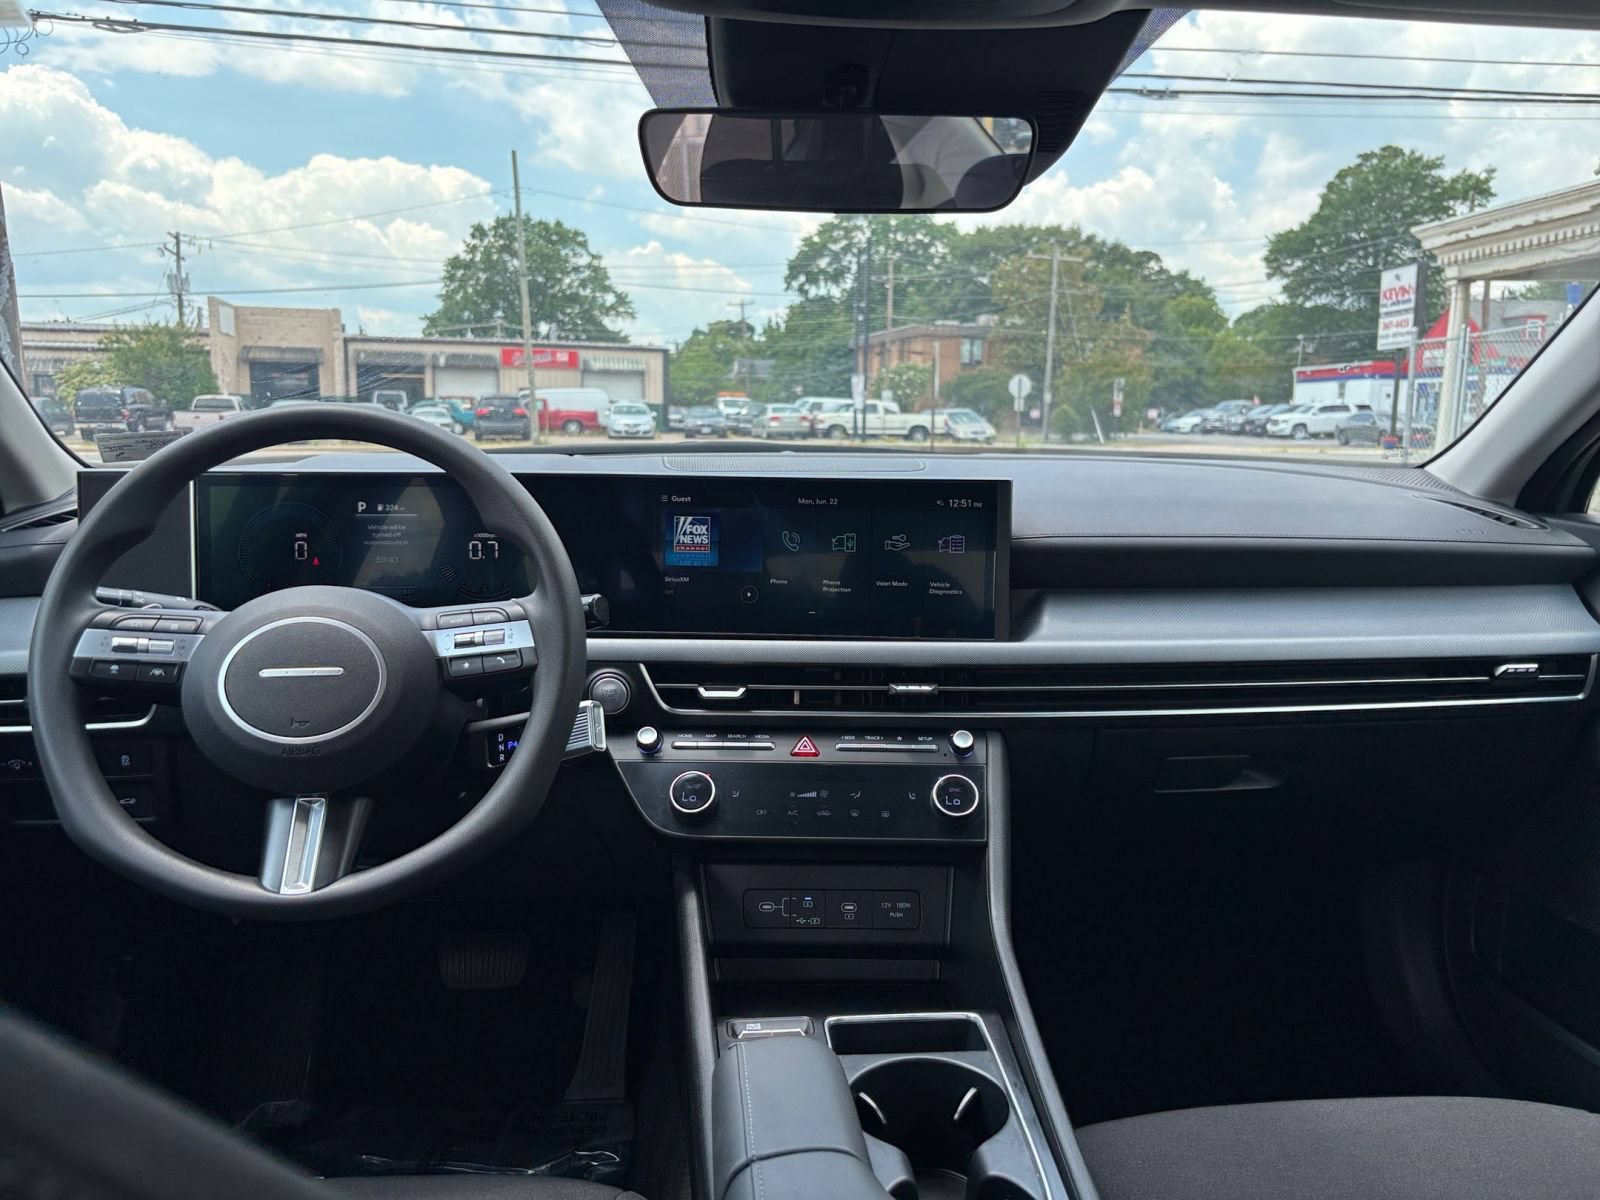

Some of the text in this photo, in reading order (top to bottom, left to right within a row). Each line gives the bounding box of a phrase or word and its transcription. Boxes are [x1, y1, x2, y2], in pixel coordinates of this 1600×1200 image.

[798, 497, 815, 505] Mon,
[949, 499, 972, 508] 12:51
[357, 501, 367, 513] P
[686, 525, 708, 534] FOX
[680, 535, 709, 544] NEWS
[294, 541, 308, 560] 0
[469, 541, 498, 559] 0.7
[929, 588, 963, 596] Diagnostics
[498, 733, 504, 741] D
[281, 745, 321, 757] AIRBAG
[499, 743, 505, 751] N
[499, 753, 505, 762] R
